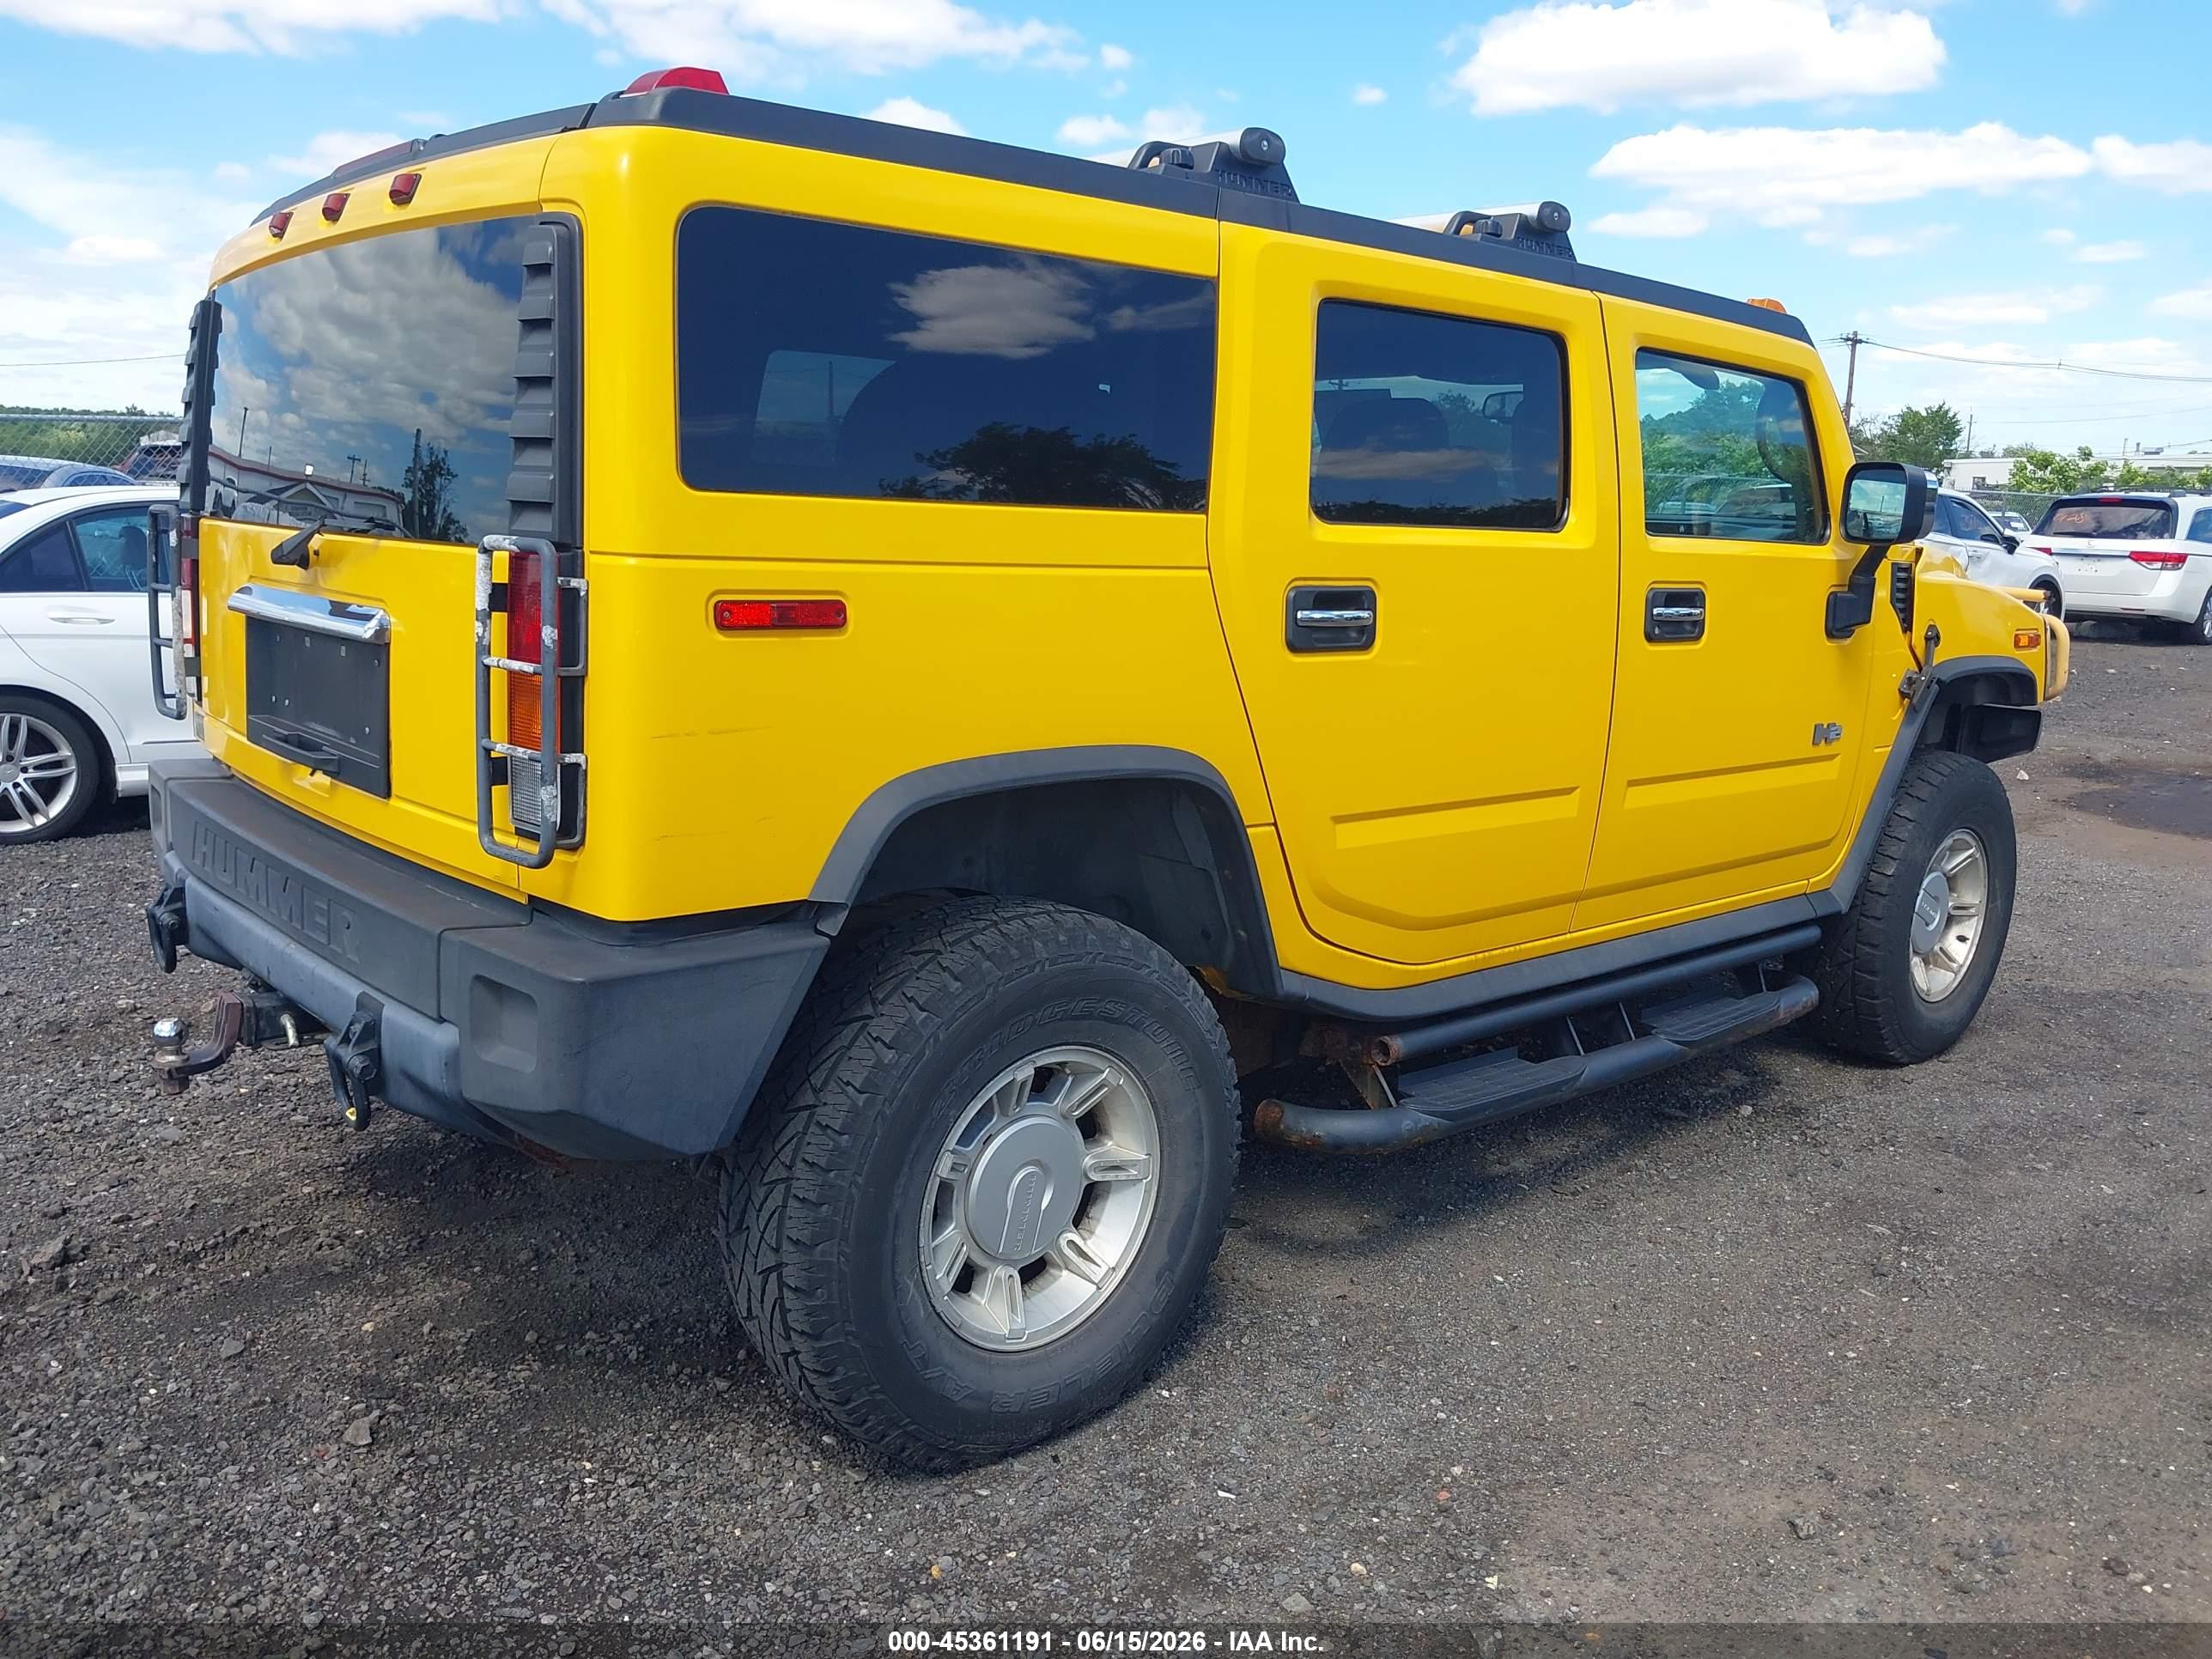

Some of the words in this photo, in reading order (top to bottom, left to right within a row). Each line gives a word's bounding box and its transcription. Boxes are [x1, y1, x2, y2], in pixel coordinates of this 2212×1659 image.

[1813, 722, 1842, 745] H2
[191, 823, 361, 963] HUMMER
[933, 996, 1201, 1113] BRIDGESTONE
